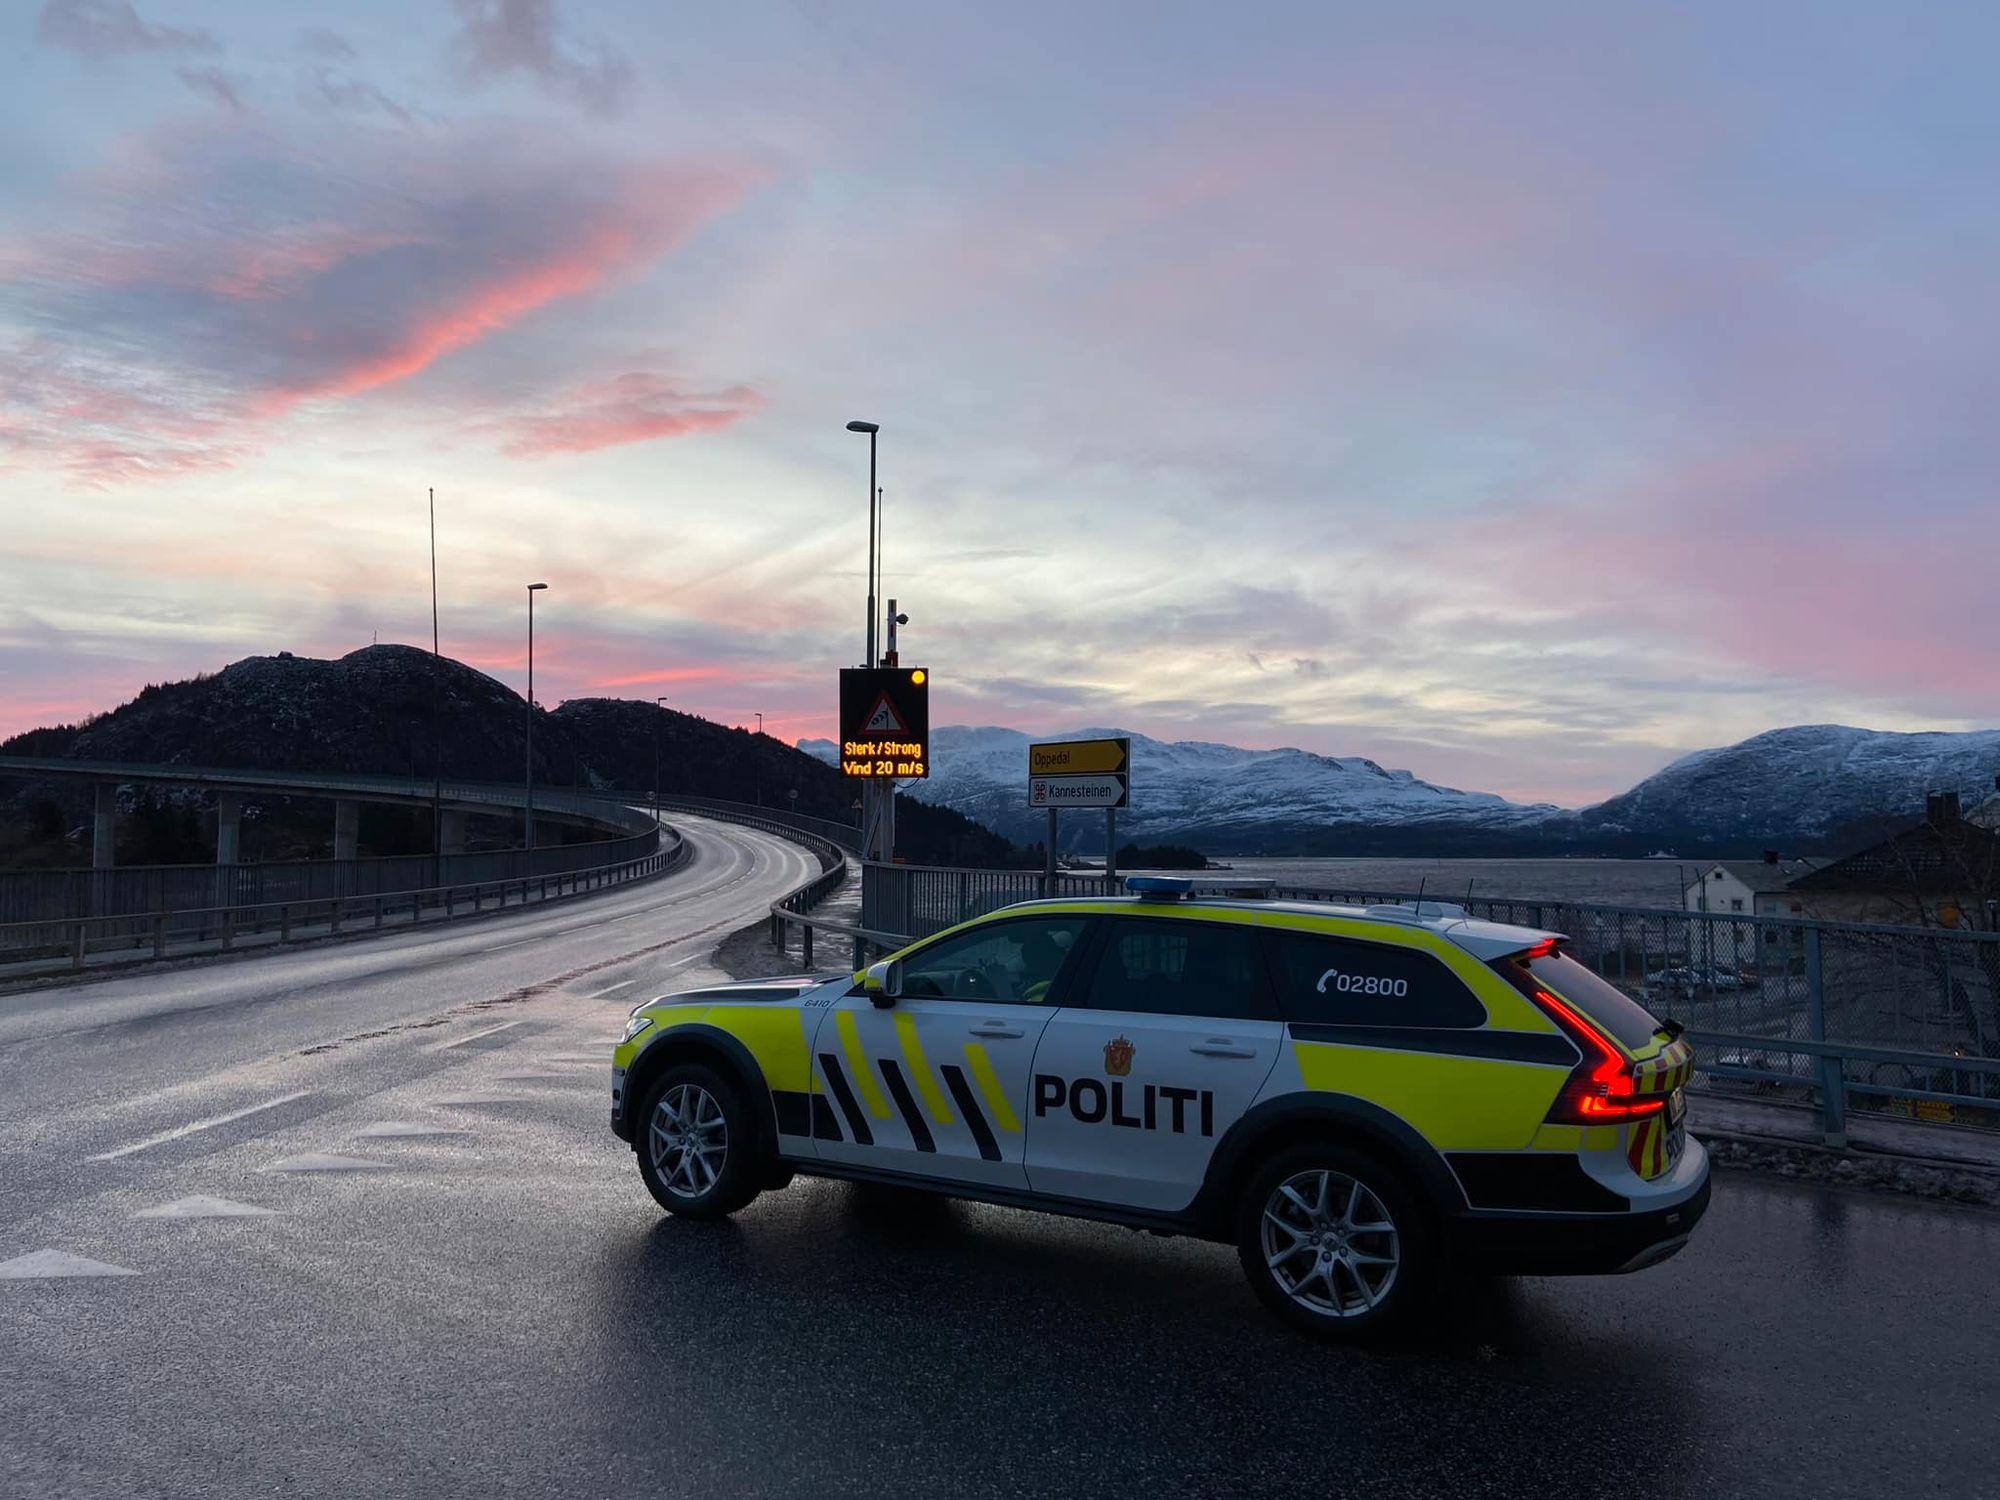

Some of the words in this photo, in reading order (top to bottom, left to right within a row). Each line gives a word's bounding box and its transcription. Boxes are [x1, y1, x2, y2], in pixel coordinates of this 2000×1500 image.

[843, 761, 872, 775] Vind
[876, 761, 893, 775] 20
[897, 761, 924, 775] m/s
[1034, 751, 1070, 768] Oppedal
[1048, 784, 1112, 798] Kannesteinen
[1336, 974, 1408, 997] 02800
[1034, 1073, 1214, 1137] POLITI
